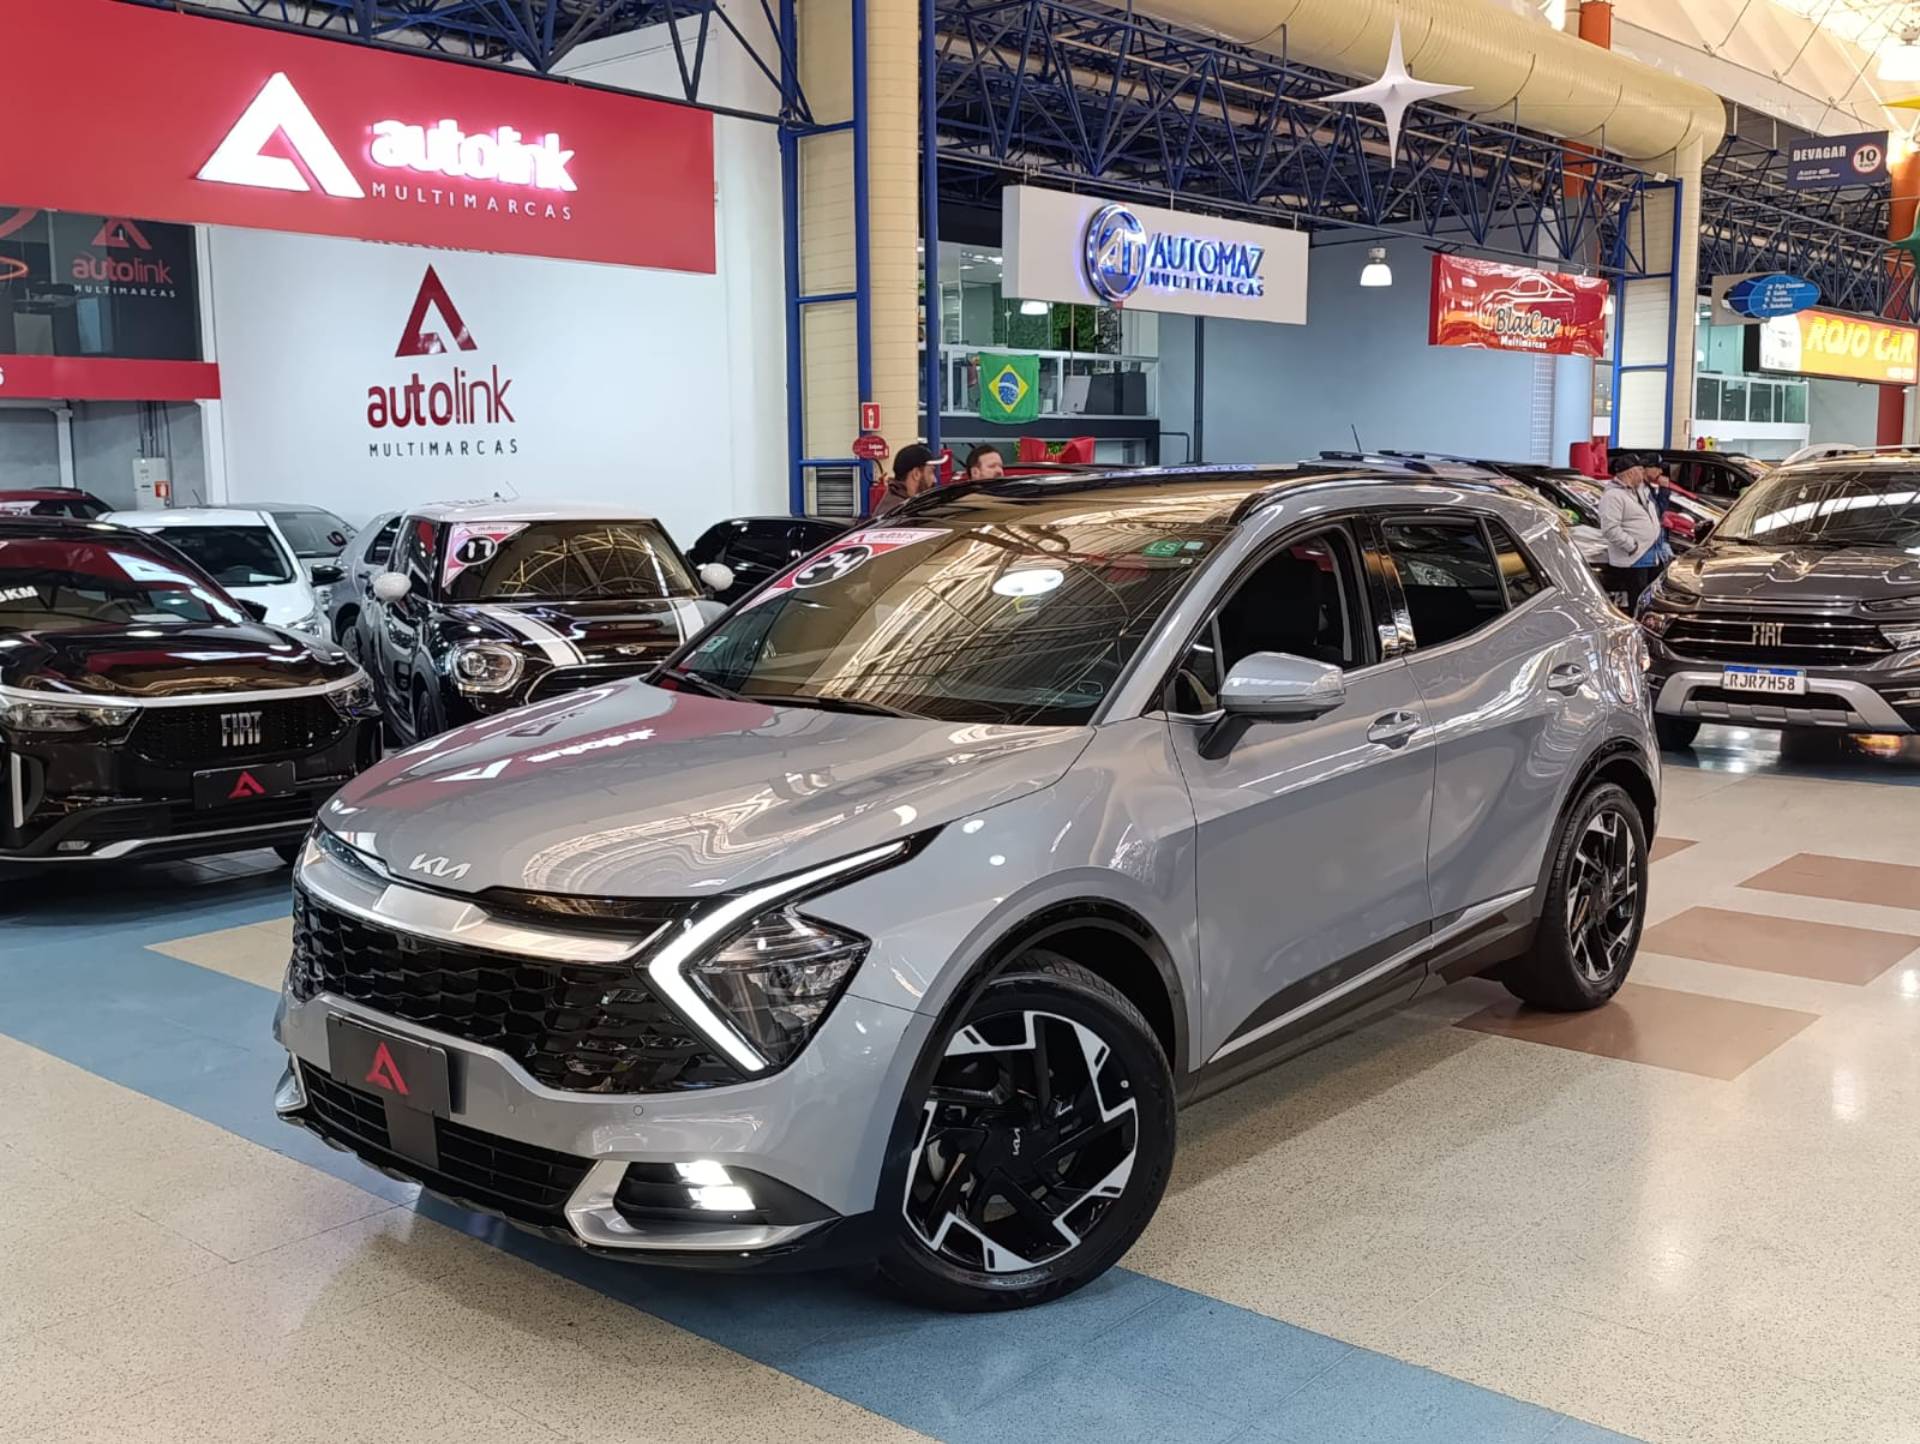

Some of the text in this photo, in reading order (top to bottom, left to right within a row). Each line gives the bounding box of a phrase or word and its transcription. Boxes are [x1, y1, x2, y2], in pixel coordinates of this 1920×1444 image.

[371, 119, 578, 192] autolink
[1793, 145, 1847, 161] DEVAGAR
[1858, 149, 1877, 162] 10
[372, 182, 572, 220] MULTIMARCAS
[1151, 233, 1265, 279] AUTOMAZ
[72, 256, 173, 284] autolink
[74, 284, 176, 298] MULTIMARCAS
[1150, 271, 1265, 297] MULTIMARCAS
[1807, 317, 1916, 362] ROJO CAR
[367, 364, 516, 428] autolink
[368, 438, 518, 457] MULTIMARCAS
[467, 540, 493, 559] 17
[798, 552, 864, 579] 24
[1752, 622, 1785, 647] FIAT
[1729, 673, 1796, 691] RJR7H58
[220, 710, 262, 747] FIAT
[409, 853, 472, 880] KIA
